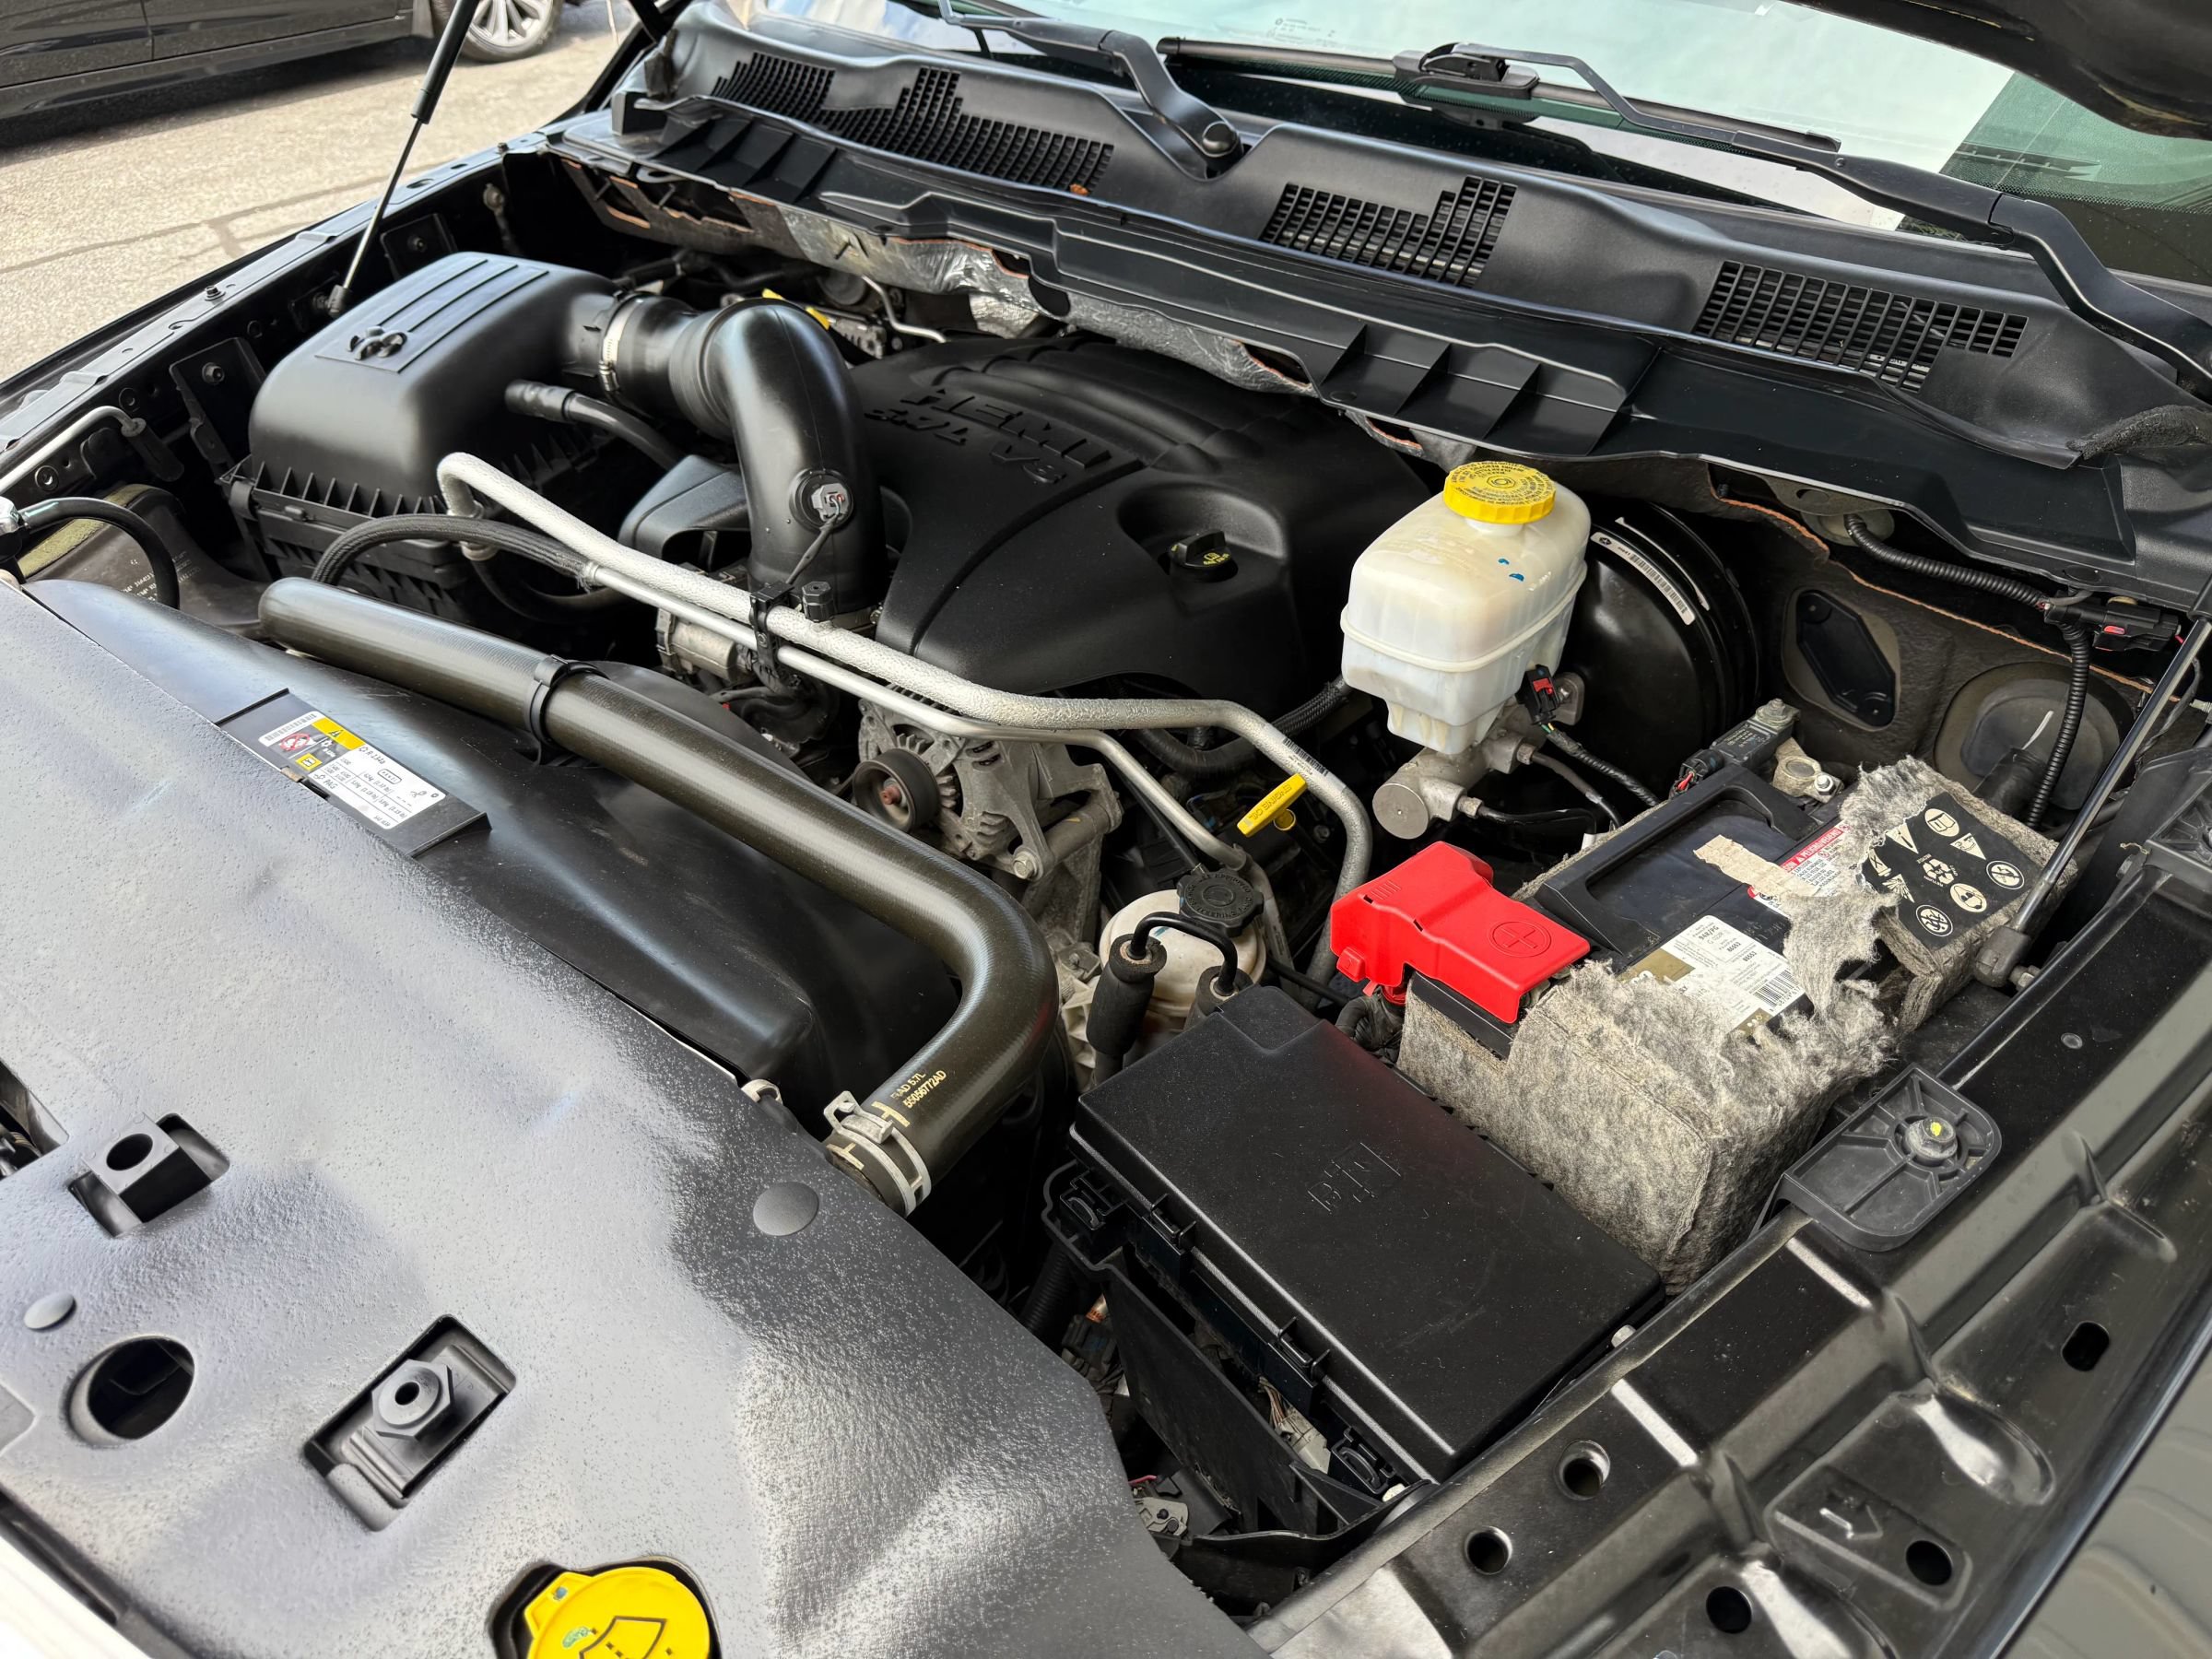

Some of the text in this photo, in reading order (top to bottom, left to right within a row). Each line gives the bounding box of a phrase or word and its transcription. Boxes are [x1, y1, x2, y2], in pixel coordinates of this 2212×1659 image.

[899, 385, 1113, 470] HEMI
[988, 440, 1067, 485] V8
[1263, 783, 1292, 811] ENGINE
[890, 1073, 926, 1100] RAD 5.7L
[902, 1070, 947, 1108] 55056772AD
